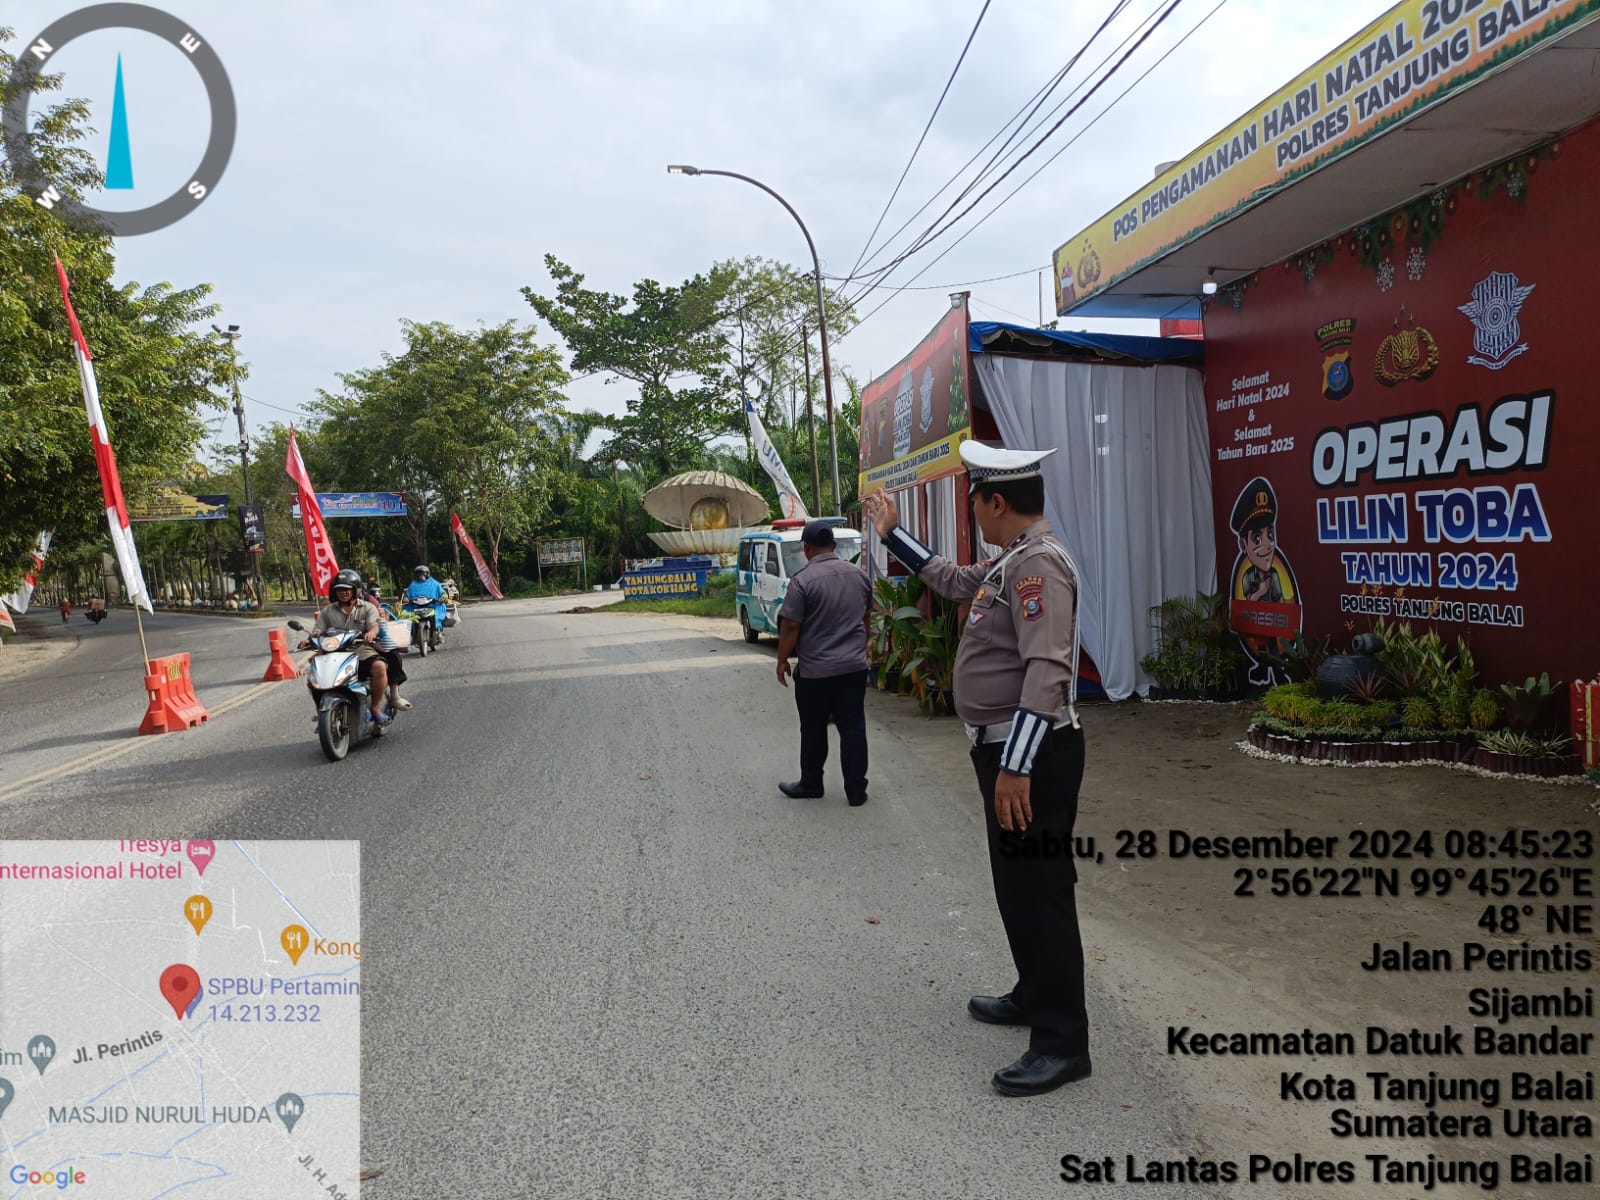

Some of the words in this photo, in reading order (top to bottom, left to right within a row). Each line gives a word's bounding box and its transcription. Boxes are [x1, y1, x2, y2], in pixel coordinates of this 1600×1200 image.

[1276, 103, 1349, 168] POLRES
[1354, 28, 1469, 121] TANJUNG
[1112, 212, 1138, 242] POS
[1141, 124, 1258, 224] PENGAMANAN
[1262, 82, 1319, 143] HARI
[1325, 22, 1414, 104] NATAL
[1317, 319, 1351, 337] POLRES
[1231, 371, 1270, 391] Selamat
[1216, 395, 1235, 412] Hari
[1237, 388, 1263, 408] Natal
[1265, 382, 1290, 401] 2024
[1248, 408, 1255, 422] &
[1234, 424, 1272, 441] Selamat
[1311, 395, 1552, 486] OPERASI
[1217, 446, 1243, 461] Tahun
[1245, 443, 1268, 457] Baru
[1270, 436, 1295, 453] 2025
[1317, 493, 1408, 543] LILIN
[1415, 483, 1552, 543] TOBA
[1341, 552, 1432, 587] TAHUN
[1438, 552, 1518, 591] 2024
[624, 585, 649, 596] KOTA
[1341, 594, 1390, 615] POLRES
[1393, 598, 1463, 622] TANJUNG
[1468, 602, 1524, 627] BALAI
